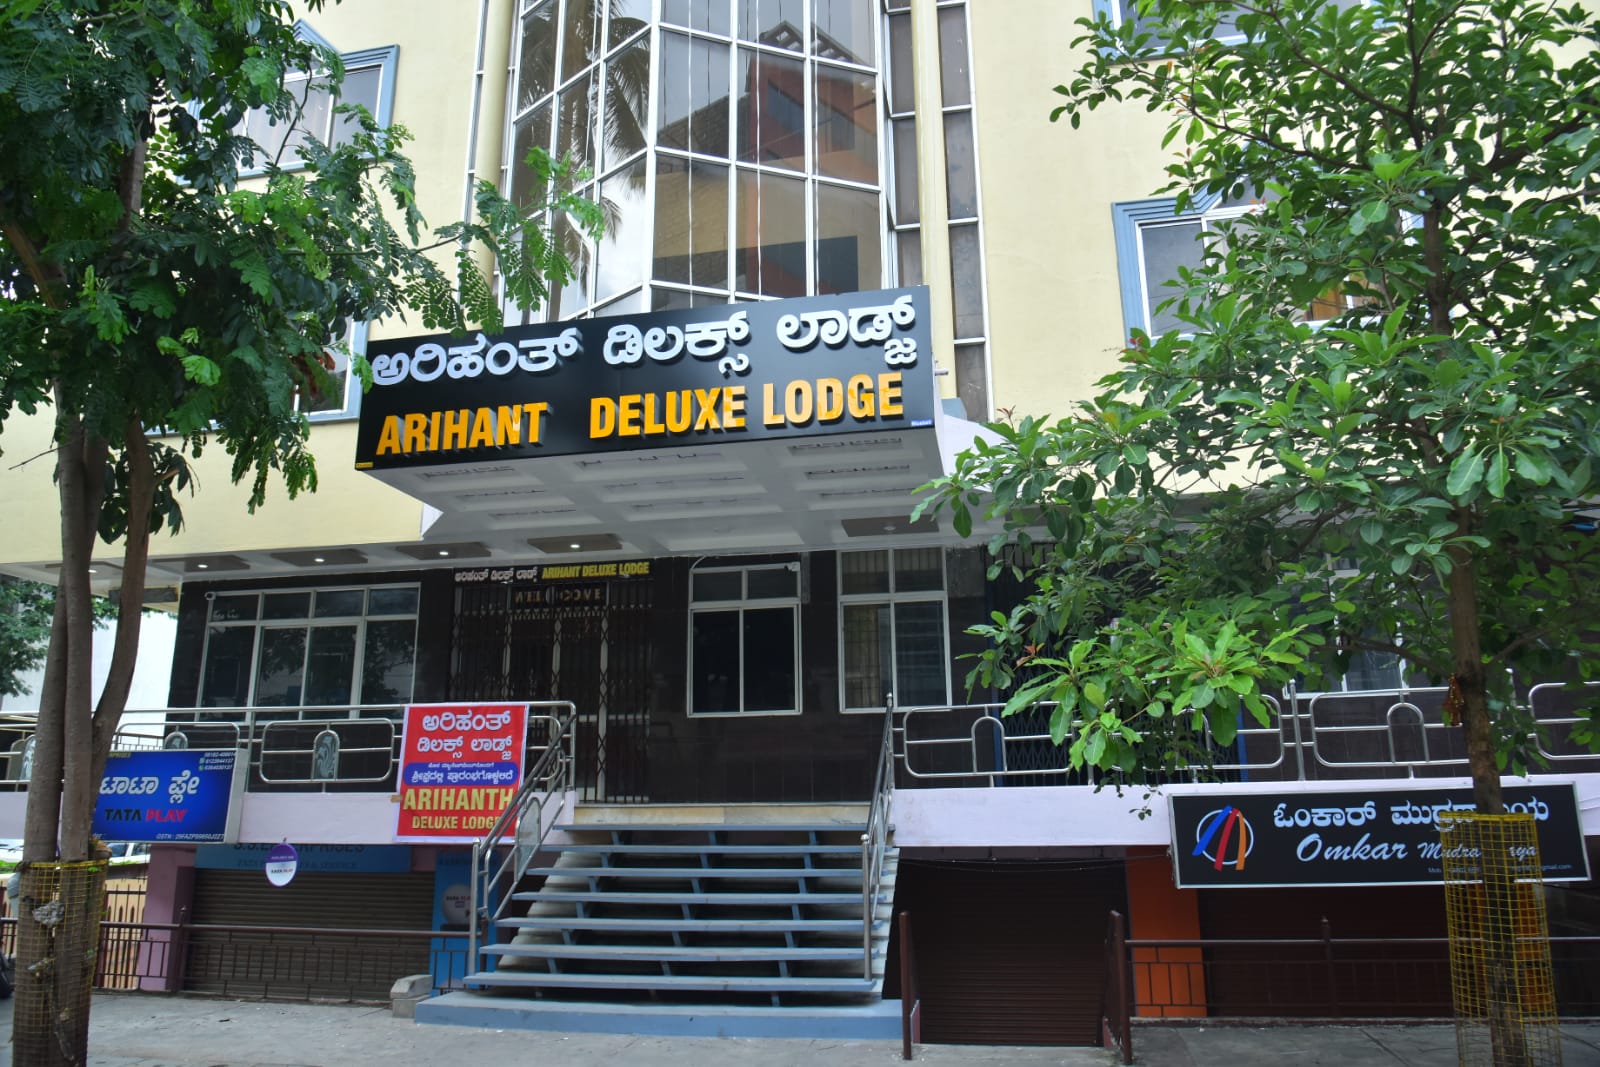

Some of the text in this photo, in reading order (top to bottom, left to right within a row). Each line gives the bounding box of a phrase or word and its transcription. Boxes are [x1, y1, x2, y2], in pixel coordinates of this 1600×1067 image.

[371, 294, 916, 386] ಅರಿಹಂತ್ ಡಿಲಕ್ಸ್ ಲಾಡ್ಜ್
[376, 372, 903, 456] ARIHANT DELUXE LODGE
[542, 565, 581, 579] ARIHANT
[582, 563, 617, 578] DELUXE
[619, 561, 650, 576] LODGE
[422, 710, 511, 731] ಅರಿಹಂತ್
[417, 735, 513, 760] ಡಿಲಕ್ಸ್ ಲಾಡ್ಜ್
[99, 769, 200, 804] ಟಾಟಾ ಪ್ಲೇ
[403, 788, 514, 811] ARIHANTH
[104, 809, 187, 822] TATA PLAY
[412, 816, 458, 829] DELUXE
[1273, 800, 1377, 828] ಓಂಕಾರ್
[1296, 832, 1408, 862] Omkar
